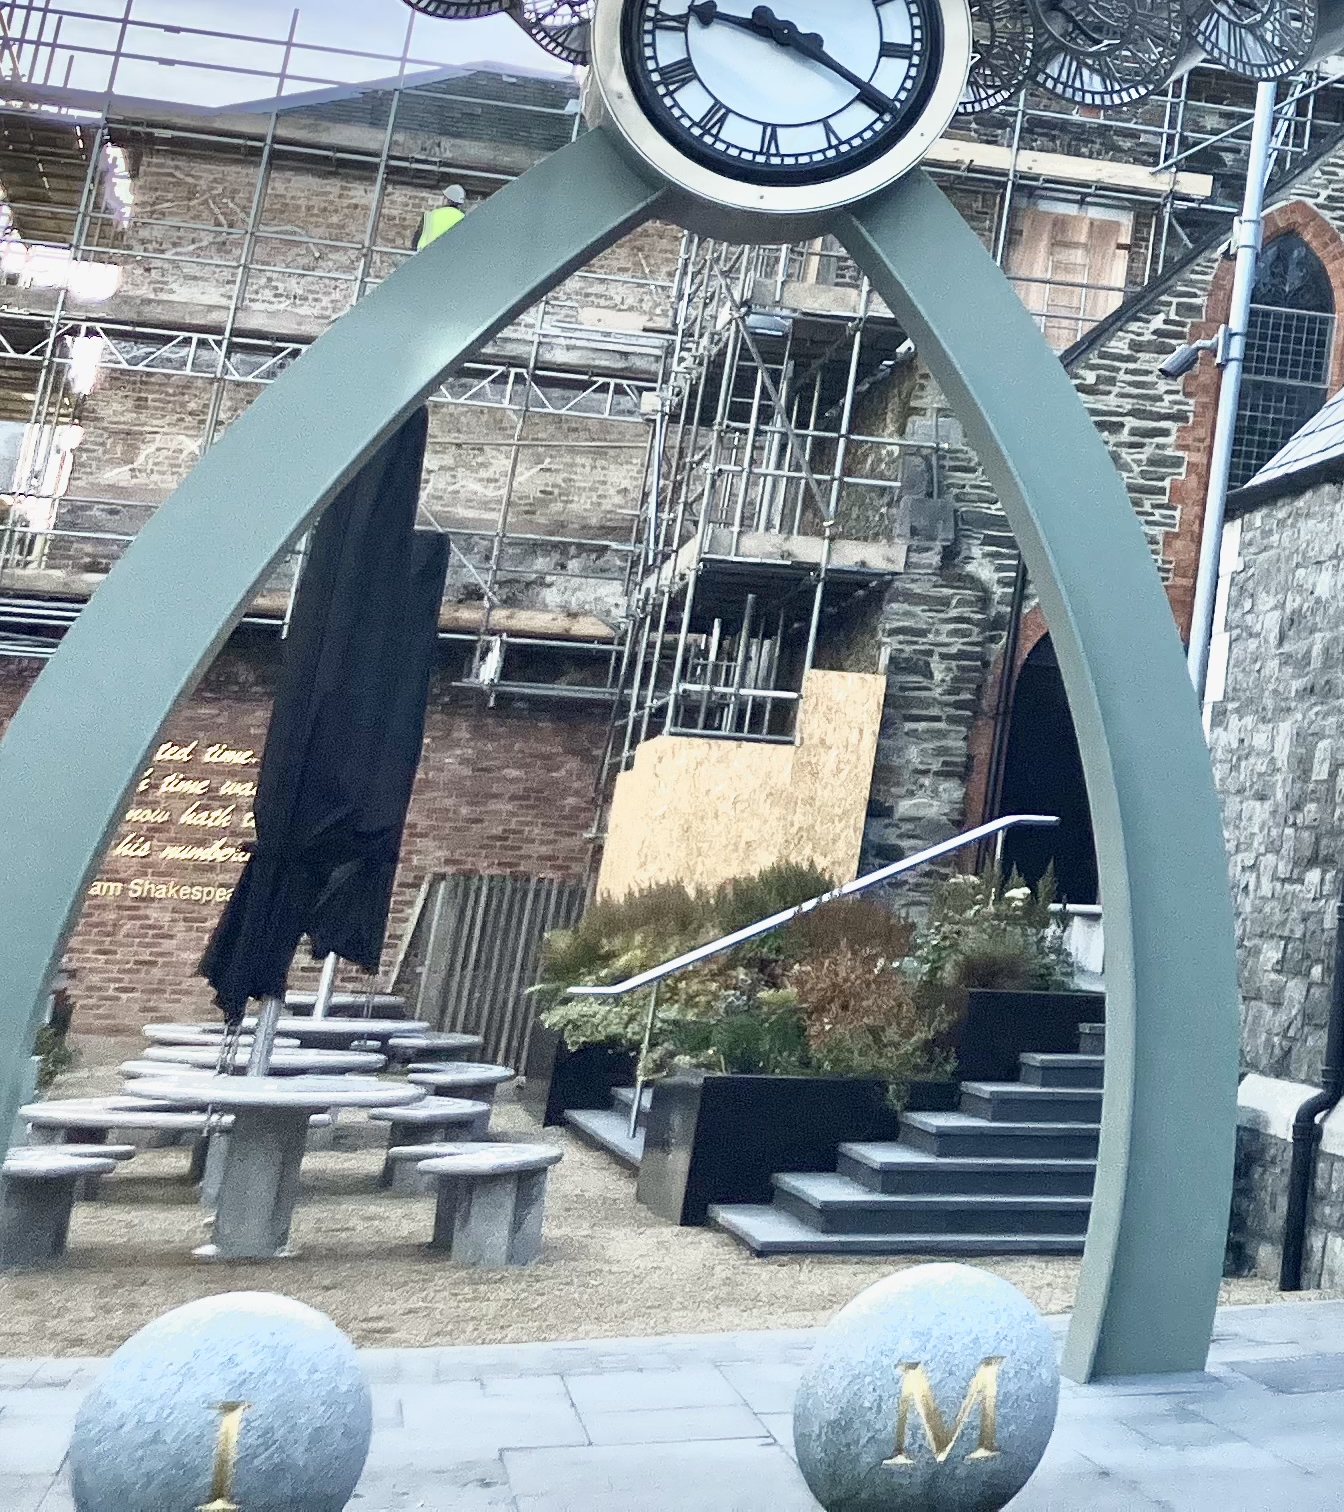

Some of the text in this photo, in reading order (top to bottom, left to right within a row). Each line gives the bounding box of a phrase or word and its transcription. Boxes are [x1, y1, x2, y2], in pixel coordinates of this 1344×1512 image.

[158, 772, 211, 795] time
[220, 779, 258, 797] wa
[125, 807, 172, 823] now
[179, 801, 236, 827] hath
[113, 831, 151, 857] his
[882, 1355, 1007, 1465] M
[195, 1399, 252, 1511] I
